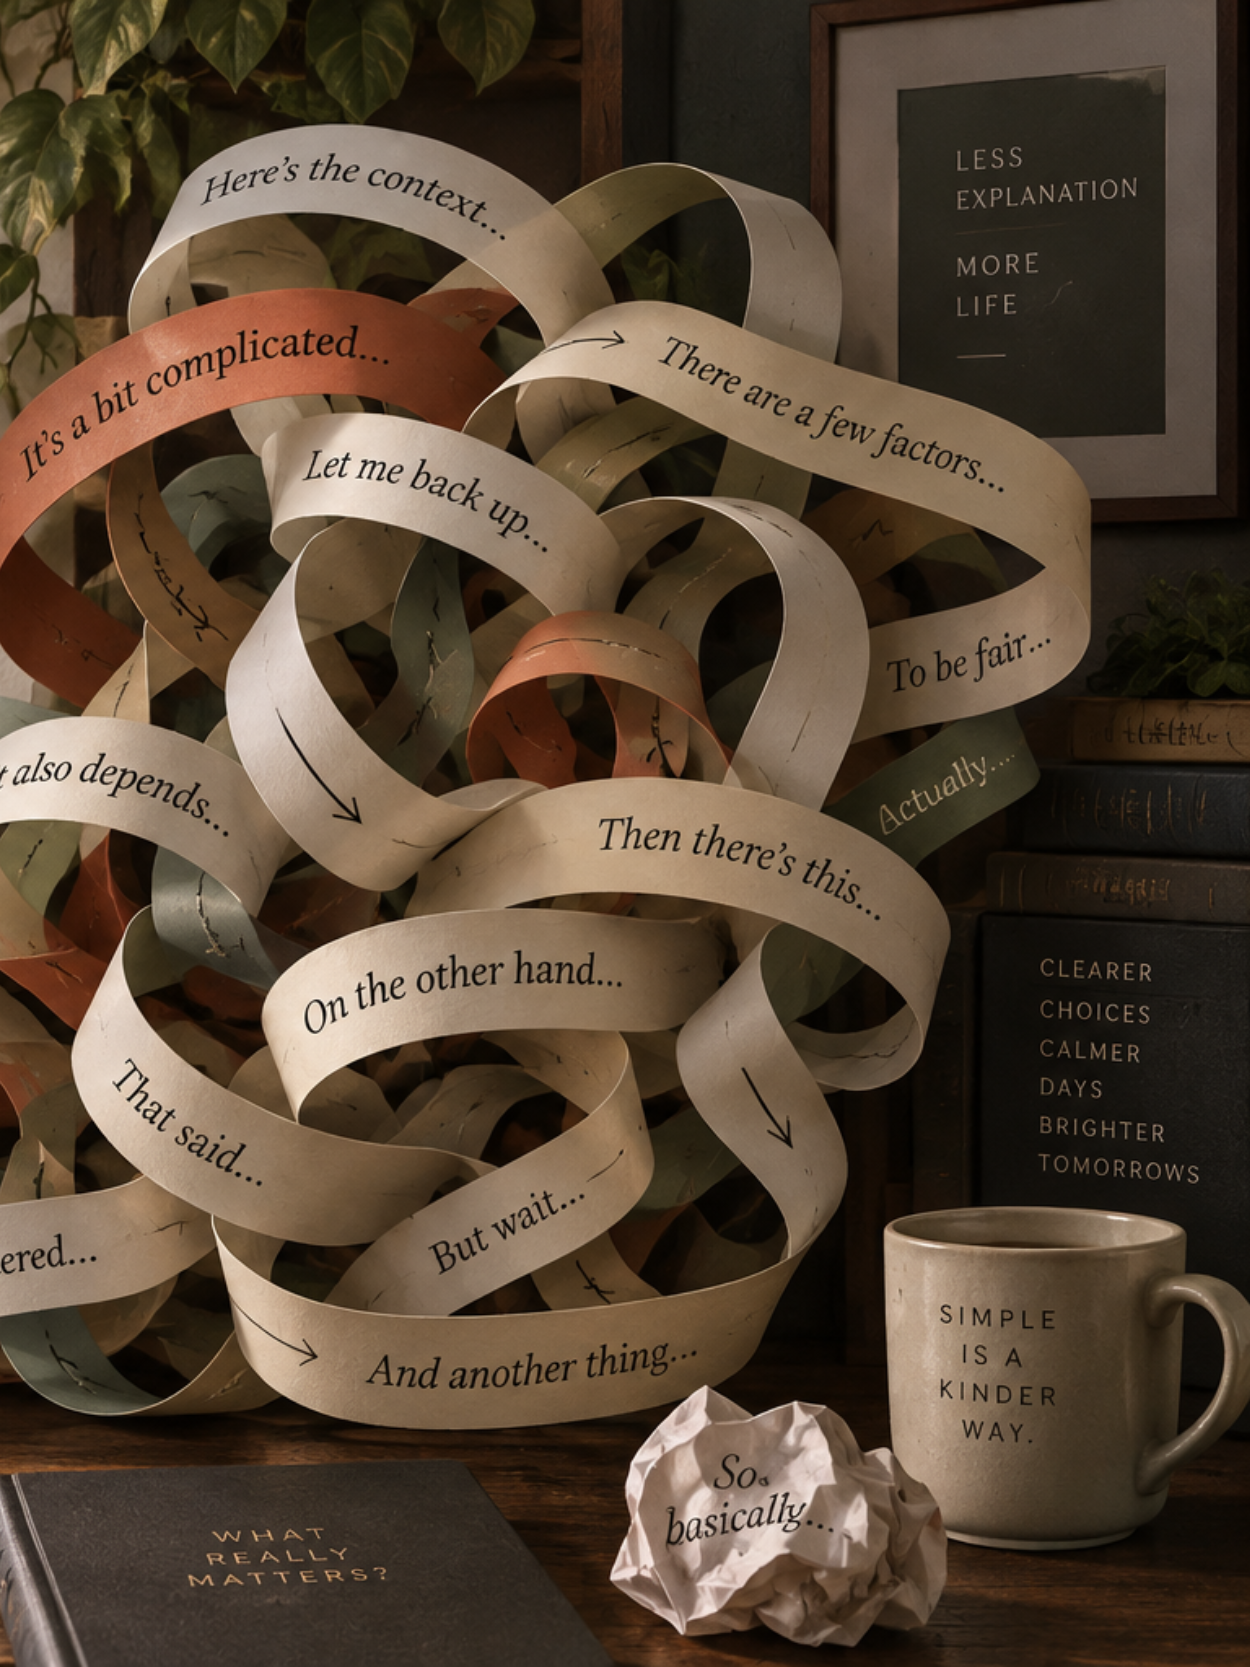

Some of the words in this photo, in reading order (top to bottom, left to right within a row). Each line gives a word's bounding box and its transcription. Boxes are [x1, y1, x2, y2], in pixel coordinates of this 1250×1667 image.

[956, 146, 1024, 172] LESS
[201, 156, 300, 206] Here’s
[308, 153, 360, 183] the
[367, 167, 505, 241] context...
[956, 177, 1138, 211] EXPLANATION
[956, 252, 1040, 277] MORE
[956, 294, 1017, 317] LIFE
[71, 415, 92, 440] a
[92, 380, 140, 425] bit
[145, 325, 391, 396] complicated...
[658, 336, 742, 395] There
[743, 383, 792, 417] are
[794, 406, 811, 427] a
[810, 405, 876, 445] few
[870, 423, 1005, 493] factors...
[301, 449, 352, 483] Let
[354, 456, 406, 484] me
[409, 458, 485, 513] back
[487, 502, 550, 554] up...
[886, 658, 927, 693] To
[934, 650, 969, 682] be
[973, 632, 1052, 683] fair...
[12, 752, 72, 786] also
[79, 752, 229, 837] depends...
[598, 815, 681, 852] Then
[801, 858, 881, 921] this...
[1039, 958, 1152, 982] CLEARER
[302, 996, 349, 1036] On
[353, 971, 407, 1010] the
[414, 955, 505, 995] other
[512, 950, 624, 989] hand...
[1039, 999, 1151, 1024] CHOICES
[1039, 1039, 1141, 1064] CALMER
[1039, 1077, 1103, 1099] DAYS
[110, 1058, 178, 1133] That
[174, 1122, 264, 1188] said...
[1039, 1116, 1165, 1143] BRIGHTER
[1037, 1153, 1200, 1184] TOMORROWS
[428, 1227, 489, 1275] But
[490, 1188, 586, 1241] wait...
[940, 1304, 1056, 1330] SIMPLE
[366, 1354, 442, 1390] And
[449, 1352, 578, 1390] another
[585, 1342, 698, 1376] thing...
[962, 1344, 988, 1366] IS
[1004, 1347, 1022, 1368] A
[940, 1378, 1056, 1406] KINDER
[961, 1419, 1033, 1444] WAY.
[665, 1492, 834, 1546] basically...
[212, 1528, 324, 1543] WHAT
[206, 1547, 348, 1566] REALLY
[187, 1567, 388, 1588] MATTERS?
